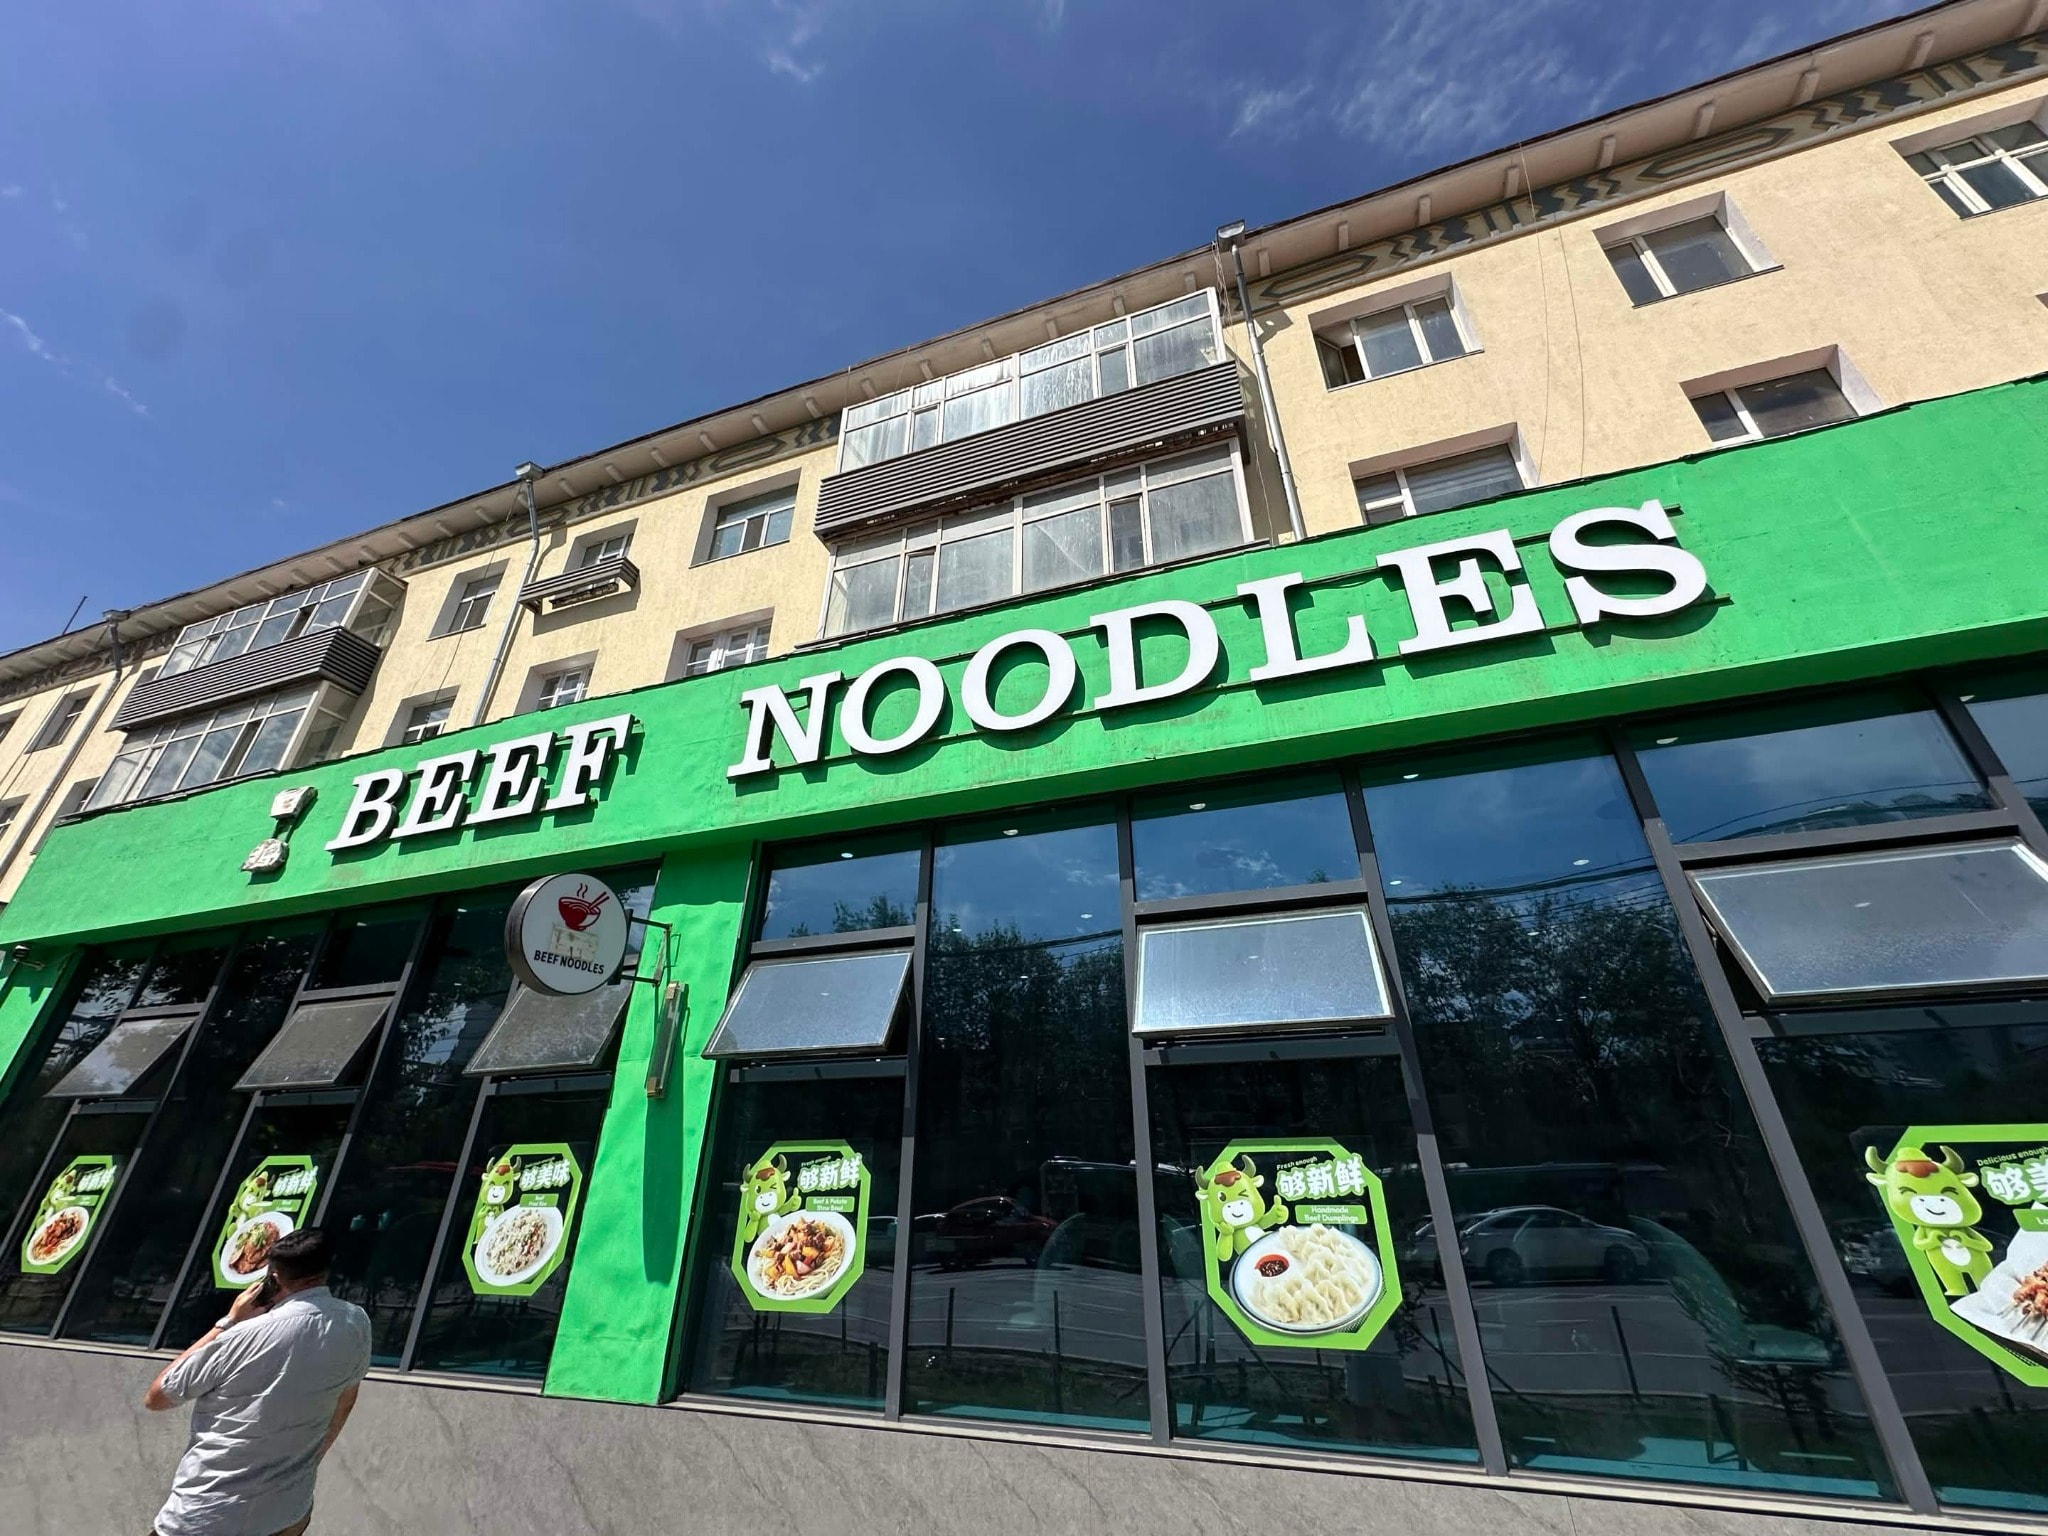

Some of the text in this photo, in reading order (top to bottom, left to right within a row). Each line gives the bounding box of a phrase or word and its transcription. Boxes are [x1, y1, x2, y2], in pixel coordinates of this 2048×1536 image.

[324, 498, 1709, 852] BEEF NOODLES
[534, 950, 605, 975] BEEF NOODLES
[798, 1154, 861, 1191] 够新鲜
[1276, 1155, 1318, 1170] Fresh enough
[1976, 1153, 2017, 1167] Delicious
[520, 1159, 570, 1191] 够美味
[1277, 1155, 1366, 1200] 够新鲜
[1304, 1214, 1359, 1223] Beef Dumplings
[1311, 1206, 1349, 1214] Handmade
